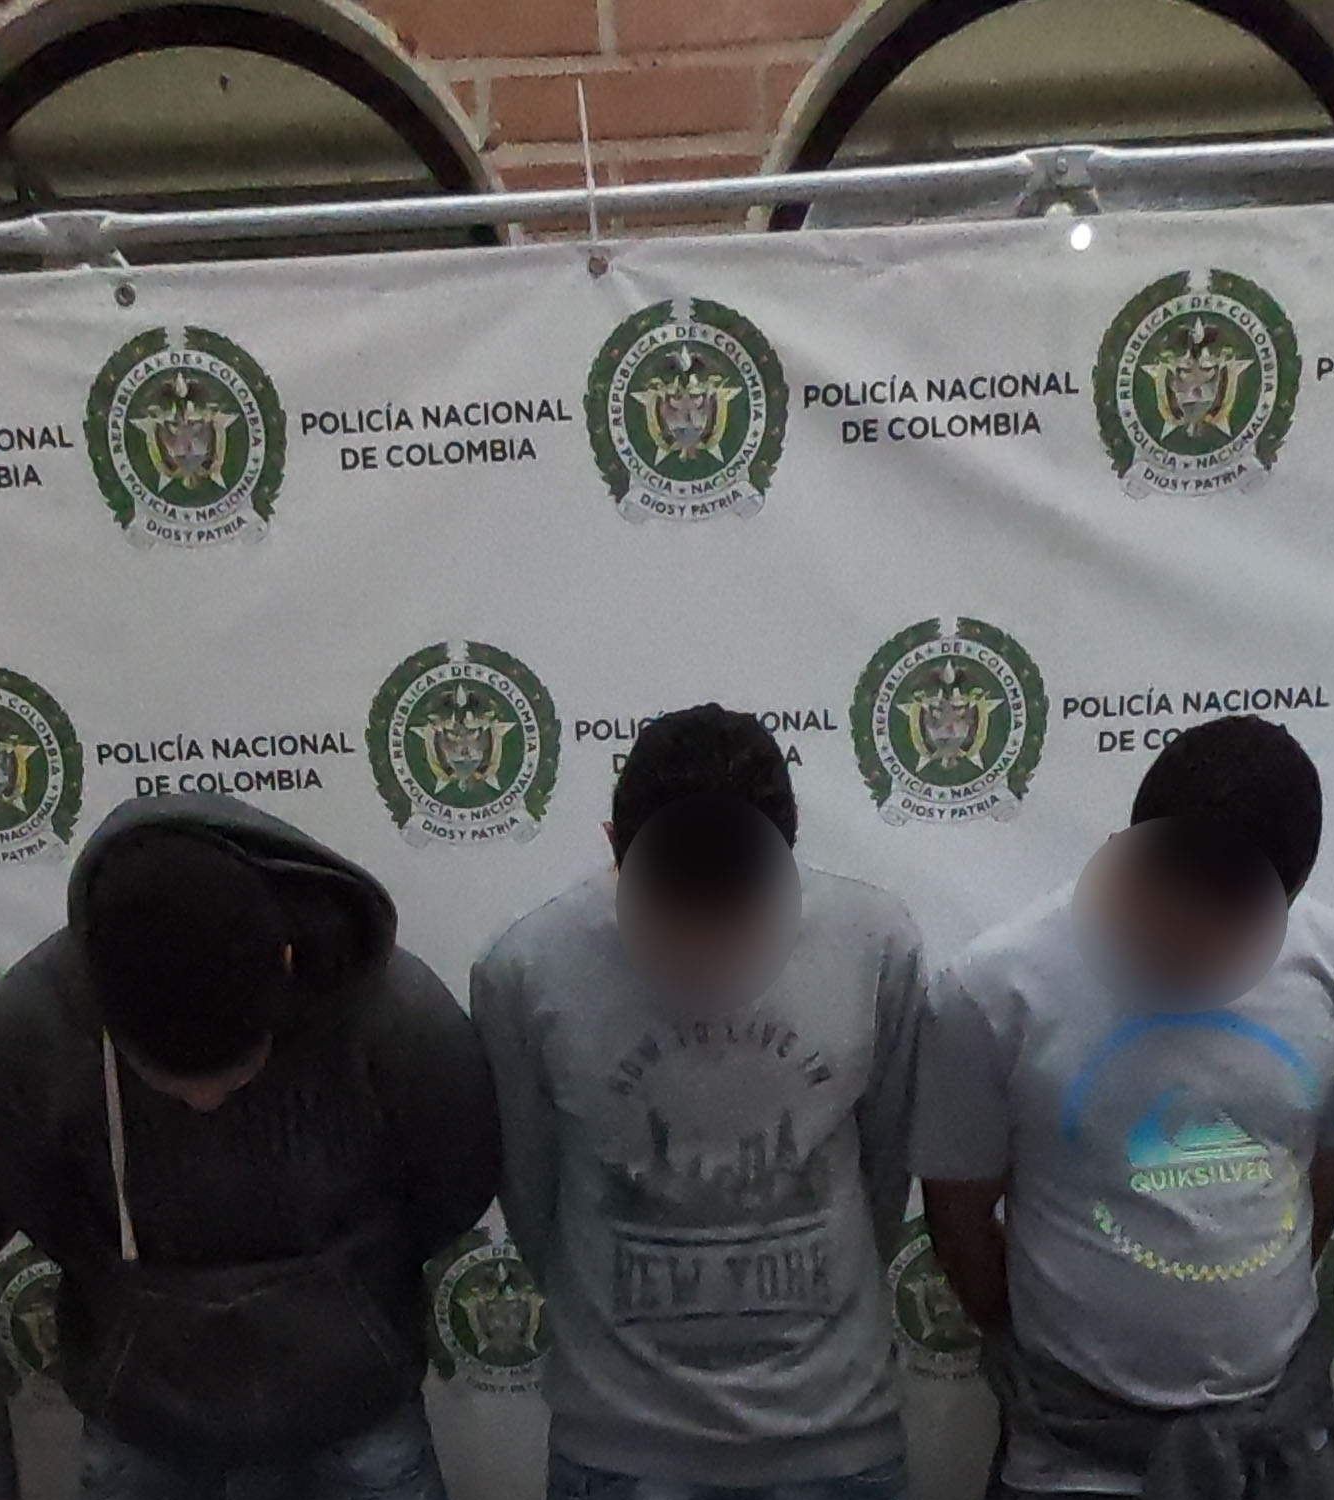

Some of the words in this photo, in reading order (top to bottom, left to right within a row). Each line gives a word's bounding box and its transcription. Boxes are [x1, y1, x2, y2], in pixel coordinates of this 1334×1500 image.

[803, 374, 918, 409] POLICÍA
[926, 372, 1079, 403] NACIONAL
[301, 403, 413, 435] POLICÍA
[423, 398, 572, 430] NACIONAL
[842, 419, 879, 444] DE
[888, 411, 1041, 441] COLOMBIA
[340, 448, 377, 470] DE
[386, 438, 536, 468] COLOMBIA
[1063, 688, 1173, 719] POLICÍA
[1182, 686, 1330, 714] NACIONAL
[97, 735, 203, 764] POLICÍA
[212, 733, 355, 759] NACIONAL
[1098, 731, 1134, 753] DE
[136, 776, 172, 797] DE
[179, 768, 323, 794] COLOMBIA
[1130, 1159, 1273, 1193] QUIKSILVER
